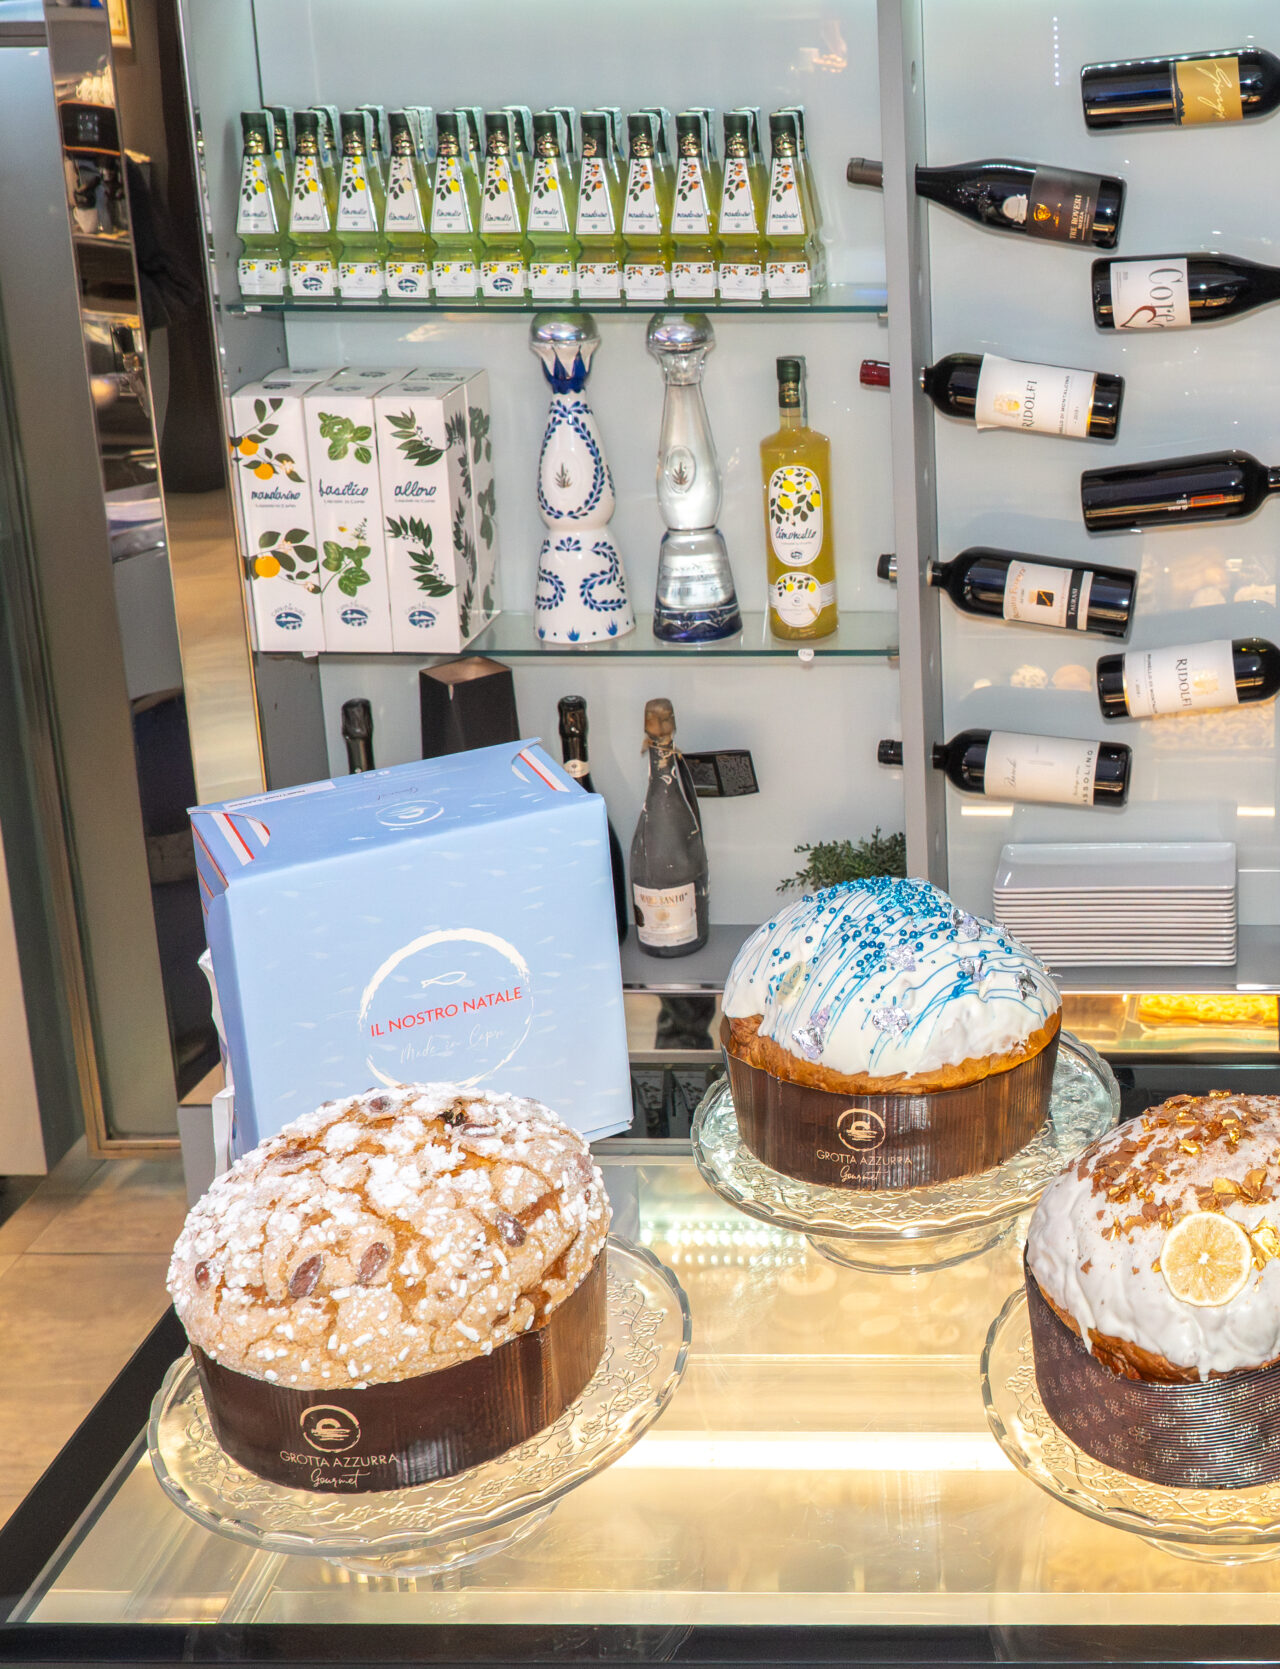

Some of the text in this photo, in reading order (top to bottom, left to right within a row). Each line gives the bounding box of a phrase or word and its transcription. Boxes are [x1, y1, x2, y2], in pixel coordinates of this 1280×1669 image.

[1021, 379, 1038, 428] RIDOLFI
[251, 486, 302, 501] mandarino
[318, 478, 369, 497] basilico
[394, 480, 437, 497] alloro
[775, 526, 817, 540] limoncello
[1175, 657, 1193, 709] RIDOLFI
[370, 986, 523, 1038] IL NOSTRO NATALE
[816, 1149, 913, 1166] GROTTA AZZURRA
[839, 1165, 889, 1183] Gourmet
[279, 1450, 400, 1468] GROTTA AZZURRA
[310, 1467, 371, 1489] Gourmet
